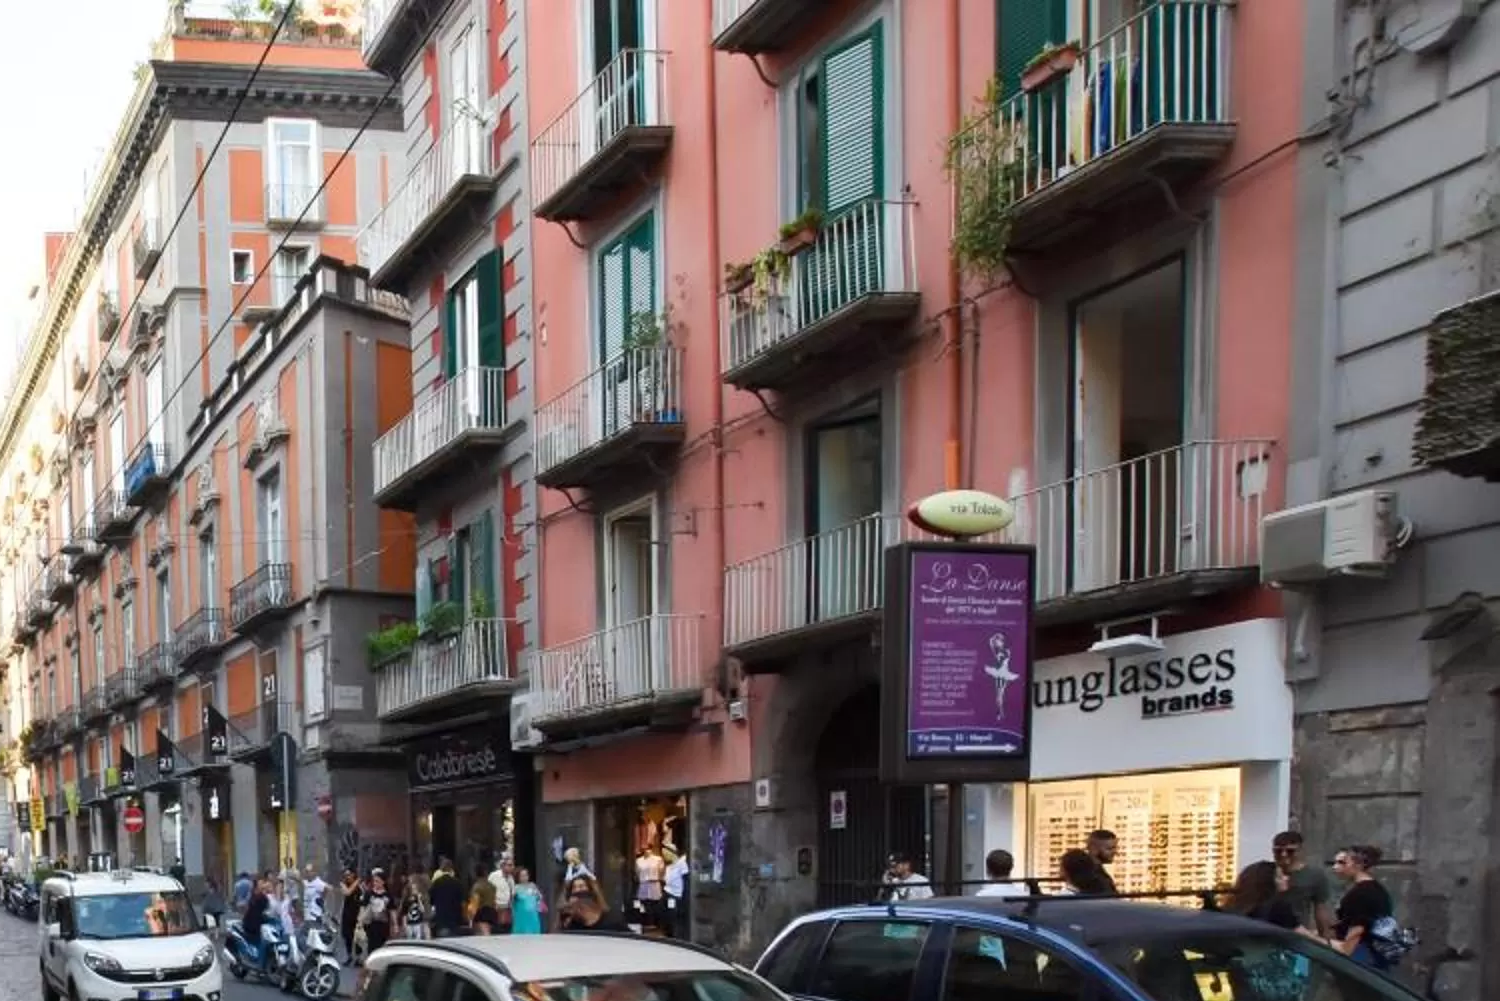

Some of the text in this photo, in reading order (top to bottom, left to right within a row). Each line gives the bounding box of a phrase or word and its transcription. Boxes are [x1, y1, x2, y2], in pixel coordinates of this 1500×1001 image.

[263, 675, 276, 697] 21
[1032, 649, 1236, 712] unglasses
[1141, 685, 1234, 716] brands
[211, 735, 226, 748] 21
